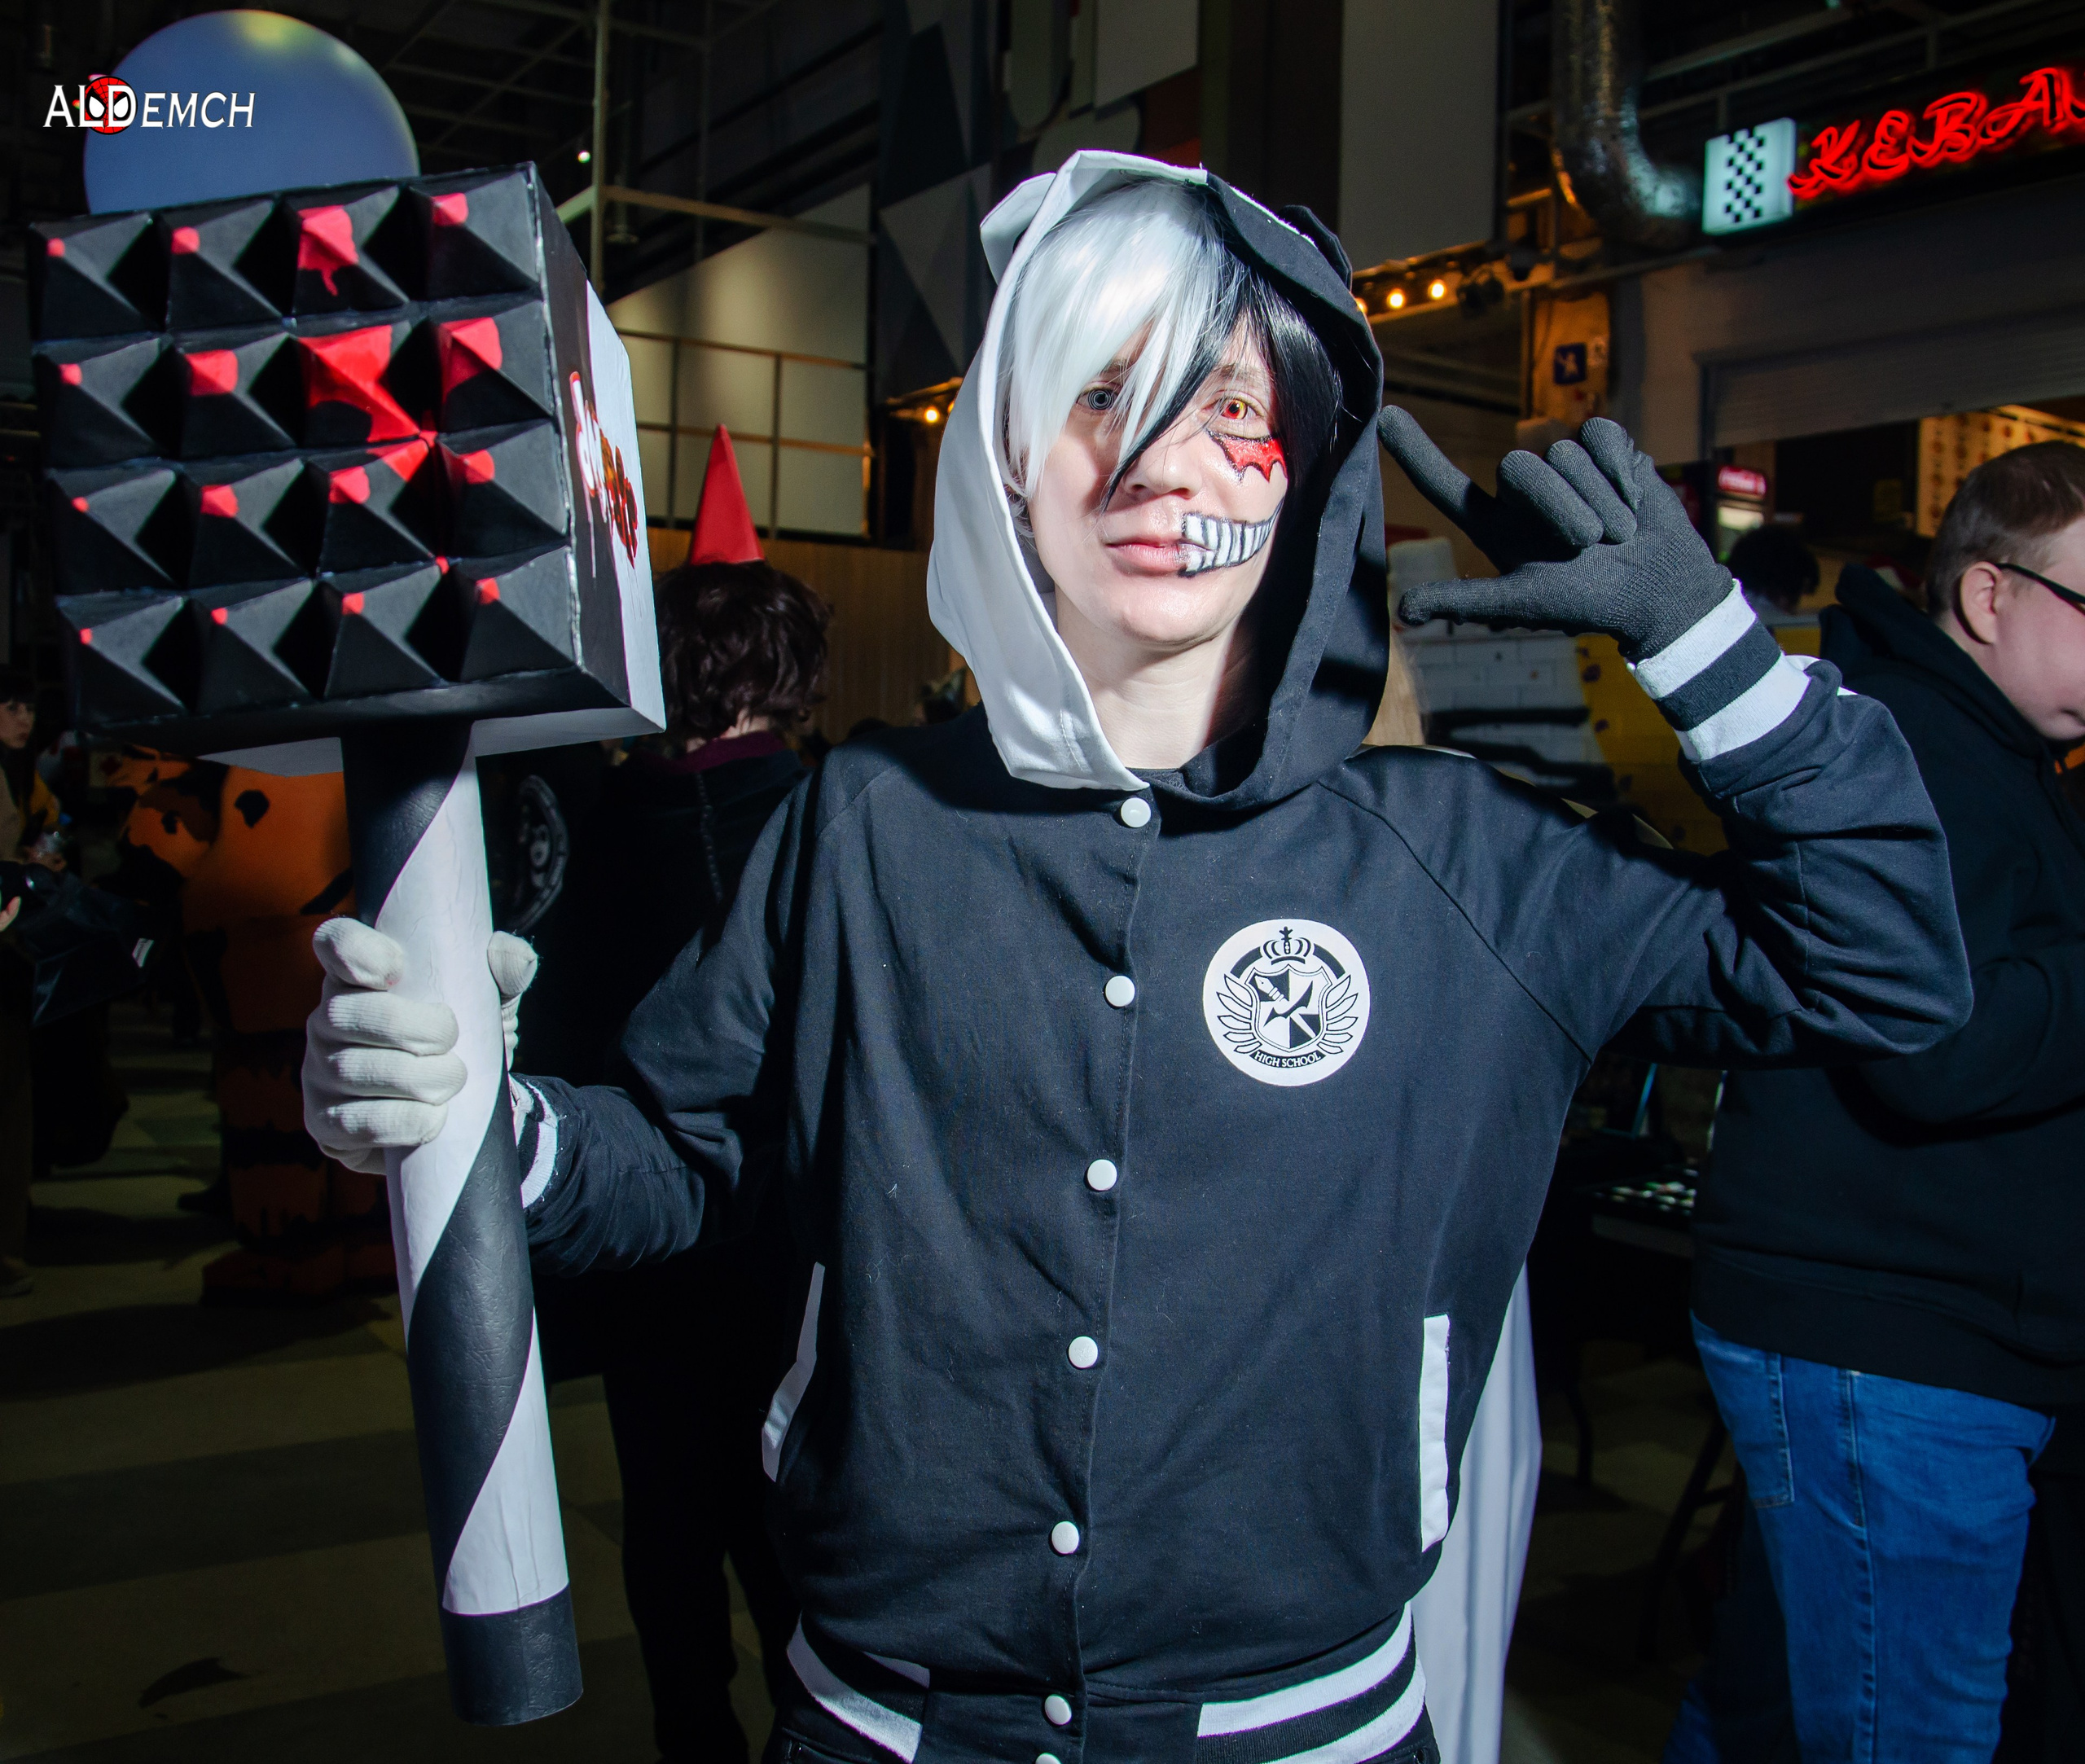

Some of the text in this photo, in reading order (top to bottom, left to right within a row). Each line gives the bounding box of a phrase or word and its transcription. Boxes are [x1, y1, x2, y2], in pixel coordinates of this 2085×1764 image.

[1787, 67, 2085, 196] KEBA
[1254, 1051, 1321, 1068] HIGH SCHOOL
